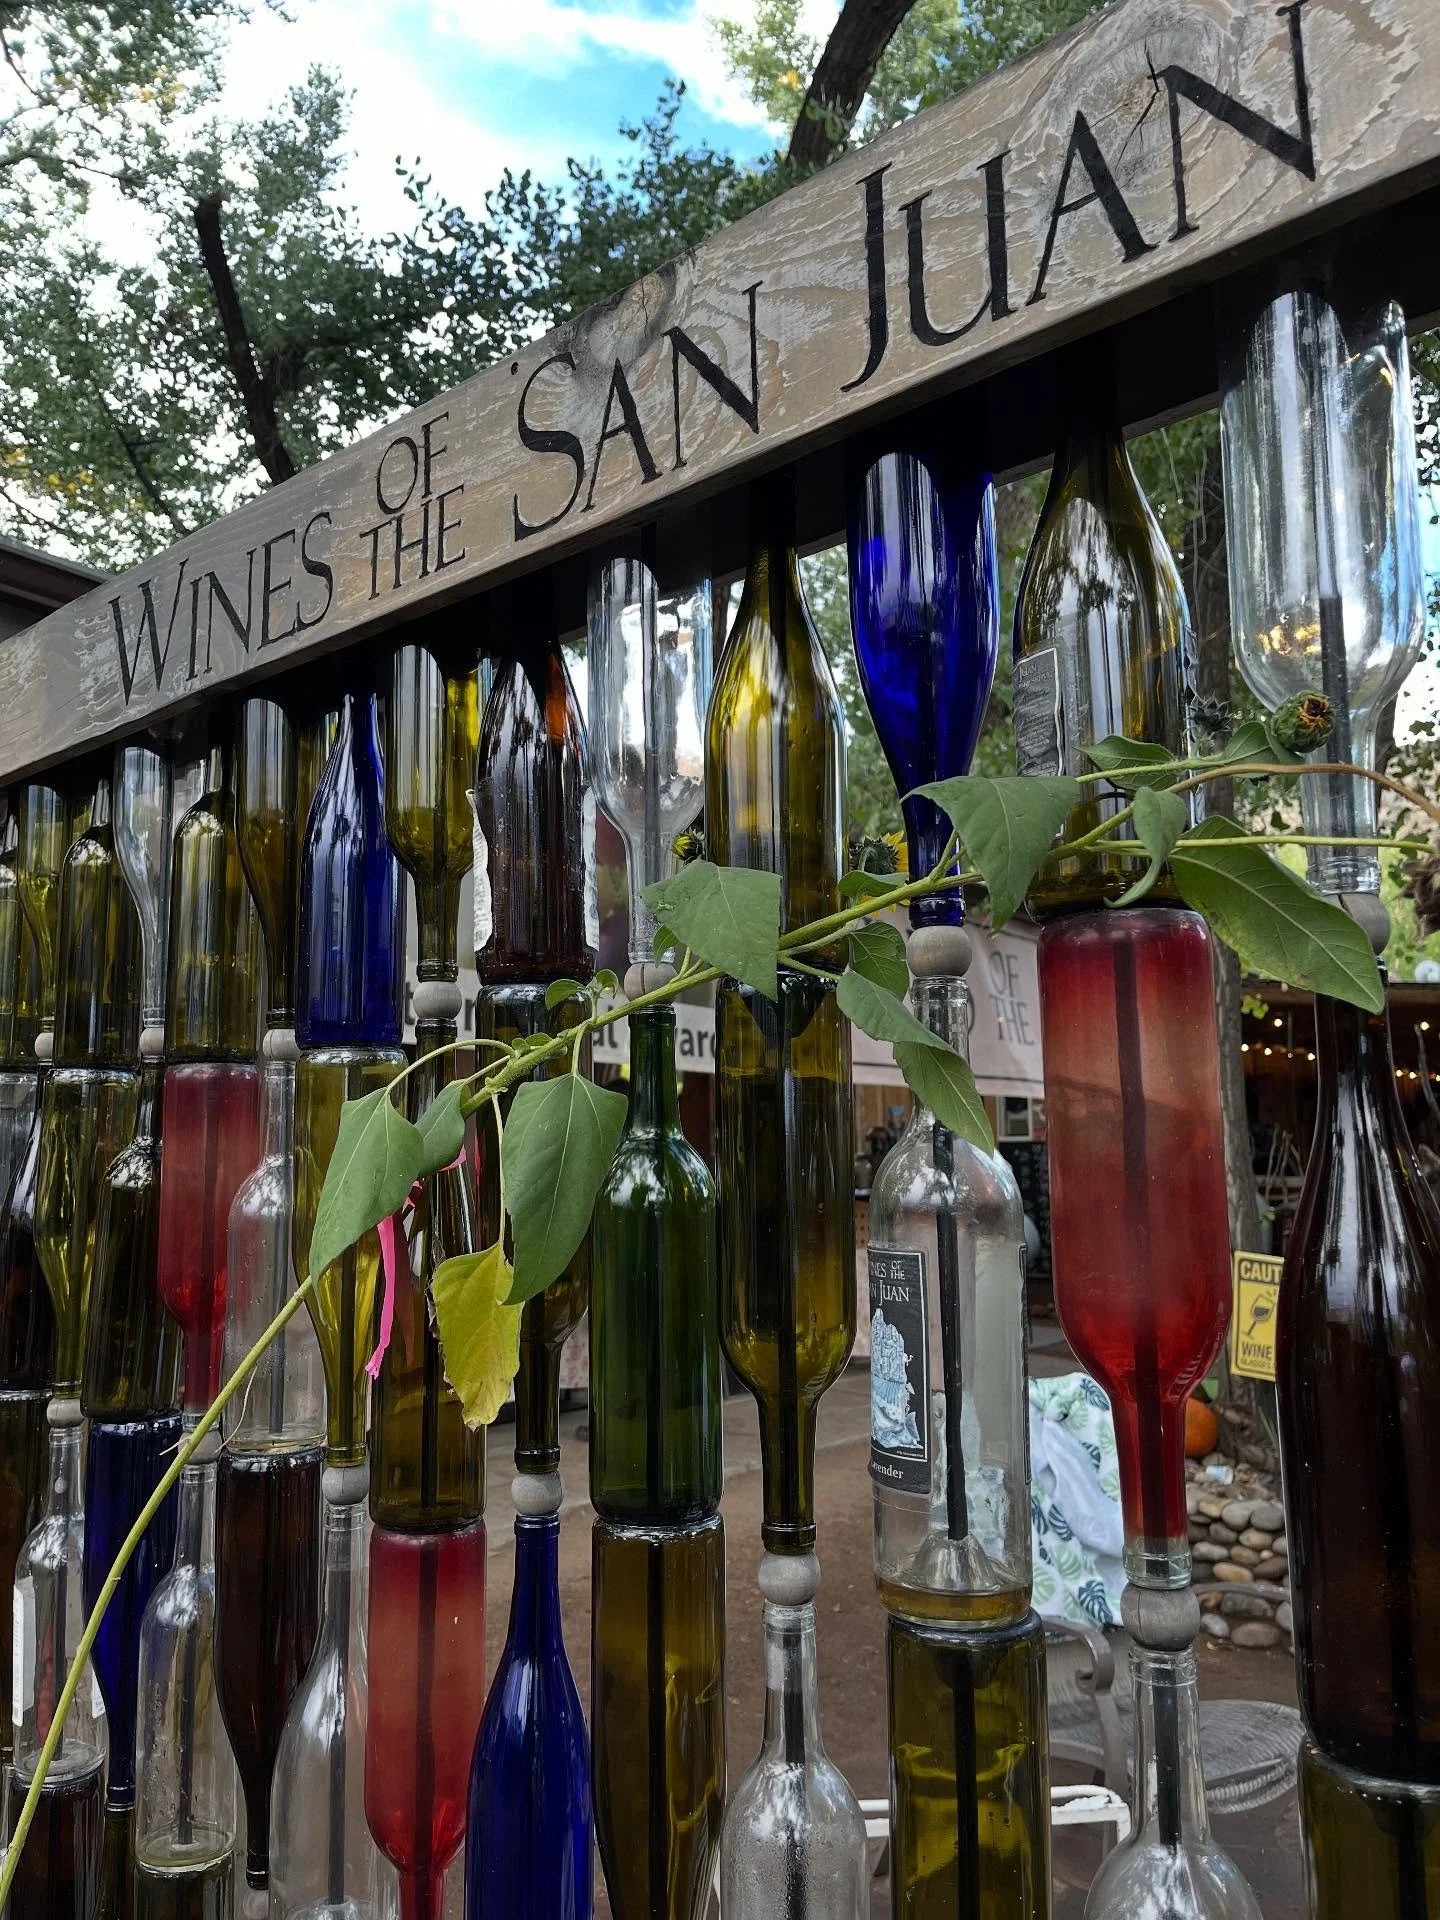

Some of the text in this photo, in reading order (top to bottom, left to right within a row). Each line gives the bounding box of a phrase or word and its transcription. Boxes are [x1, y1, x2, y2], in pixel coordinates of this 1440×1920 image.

[109, 2, 1316, 704] WINES OF THE SAN JUAN
[988, 951, 1019, 997] OF
[989, 993, 1034, 1046] THE
[889, 1269, 906, 1280] THE
[1239, 1259, 1282, 1284] CAUT
[879, 1279, 910, 1306] JUAN
[1241, 1341, 1272, 1360] WINE
[871, 1461, 904, 1479] avender
